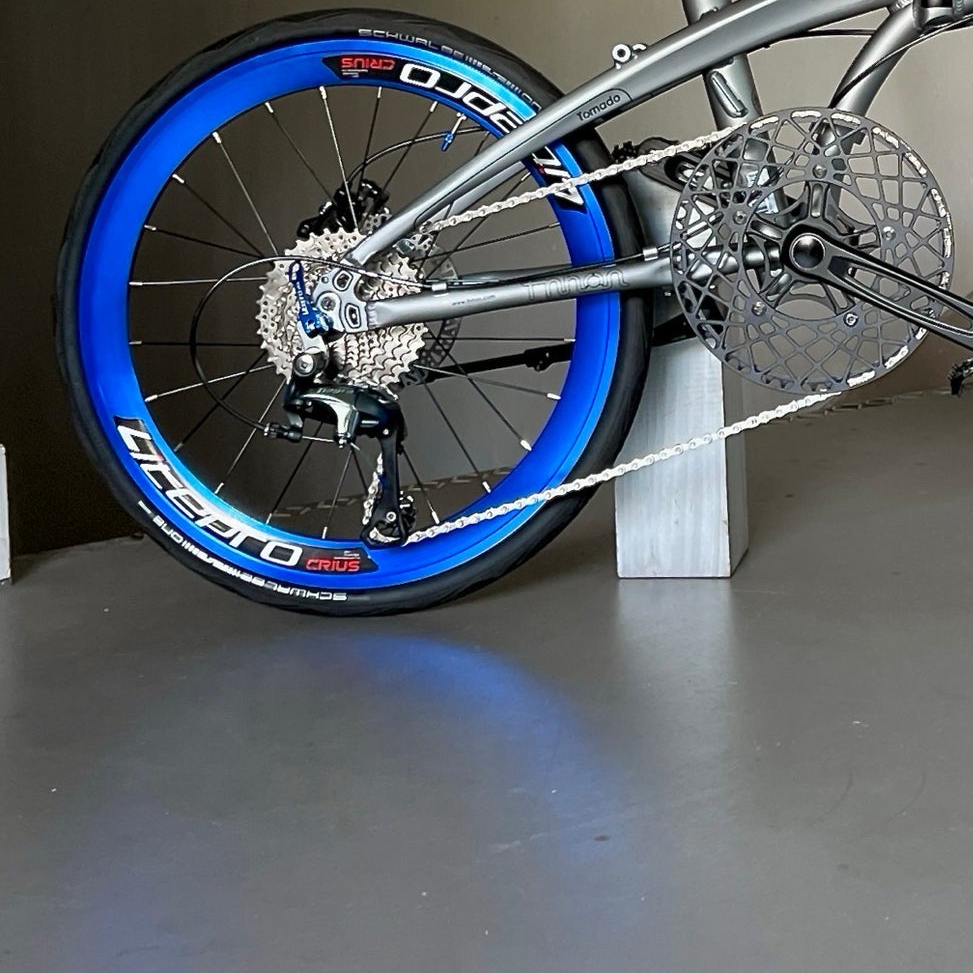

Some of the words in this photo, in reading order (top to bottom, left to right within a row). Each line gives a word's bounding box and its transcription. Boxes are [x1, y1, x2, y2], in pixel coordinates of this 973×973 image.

[341, 57, 396, 71] CRIUS
[153, 515, 184, 544] ONE
[305, 558, 361, 572] CRIUS
